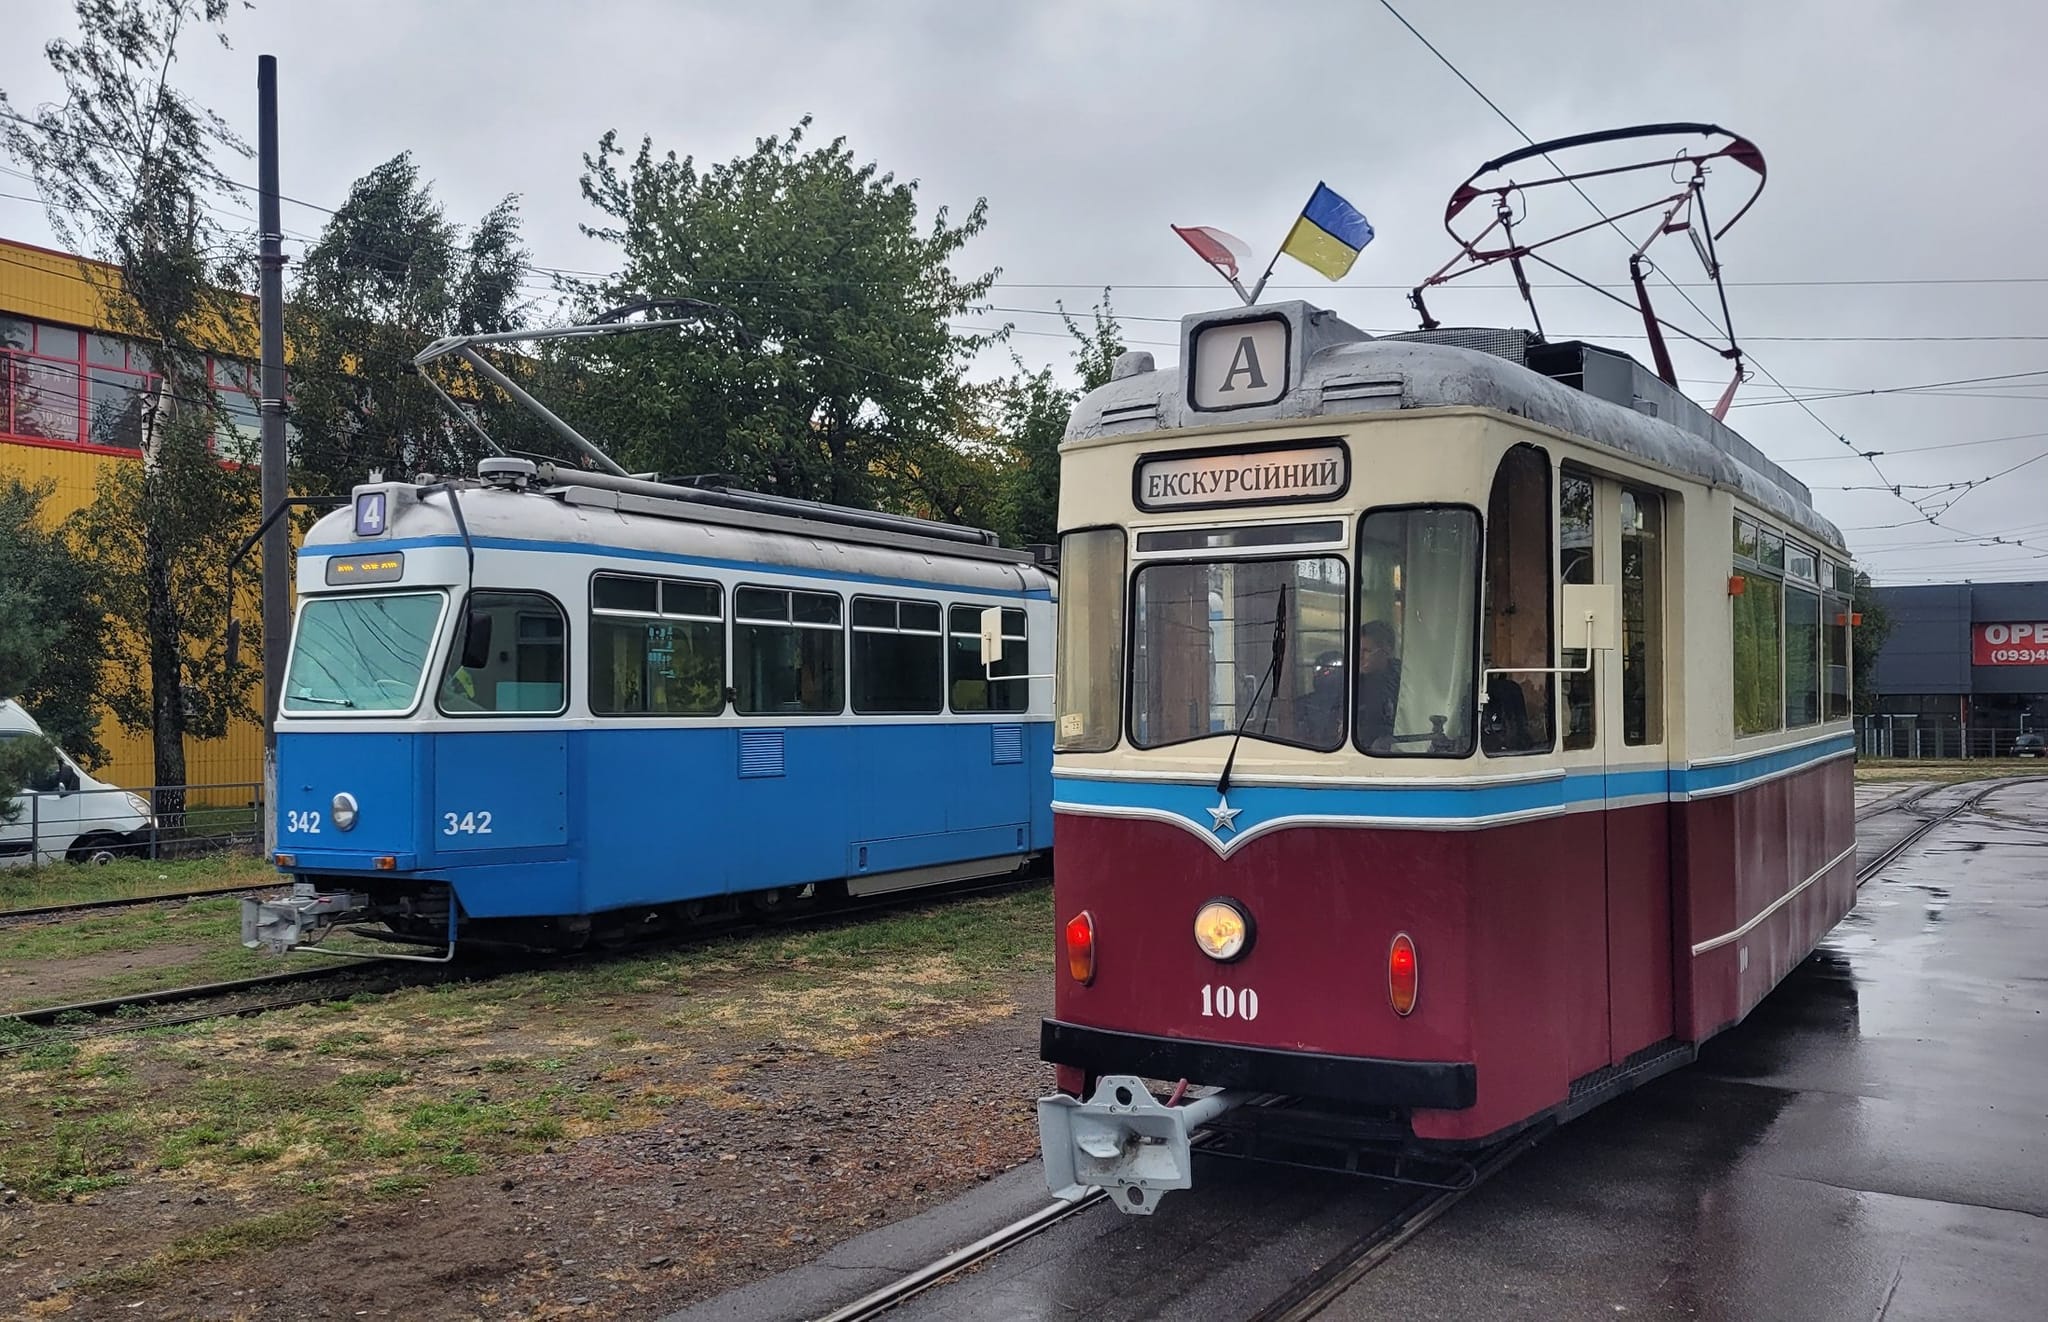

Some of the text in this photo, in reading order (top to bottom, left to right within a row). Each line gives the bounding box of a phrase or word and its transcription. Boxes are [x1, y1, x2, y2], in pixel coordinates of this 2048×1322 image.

[1219, 336, 1267, 391] А
[1147, 459, 1338, 498] ЕКСКУРСІЙНИЙ
[363, 497, 380, 529] 4
[1991, 649, 2048, 663] (093)4
[288, 811, 320, 833] 342
[443, 812, 492, 835] 342
[1202, 984, 1258, 1020] 100
